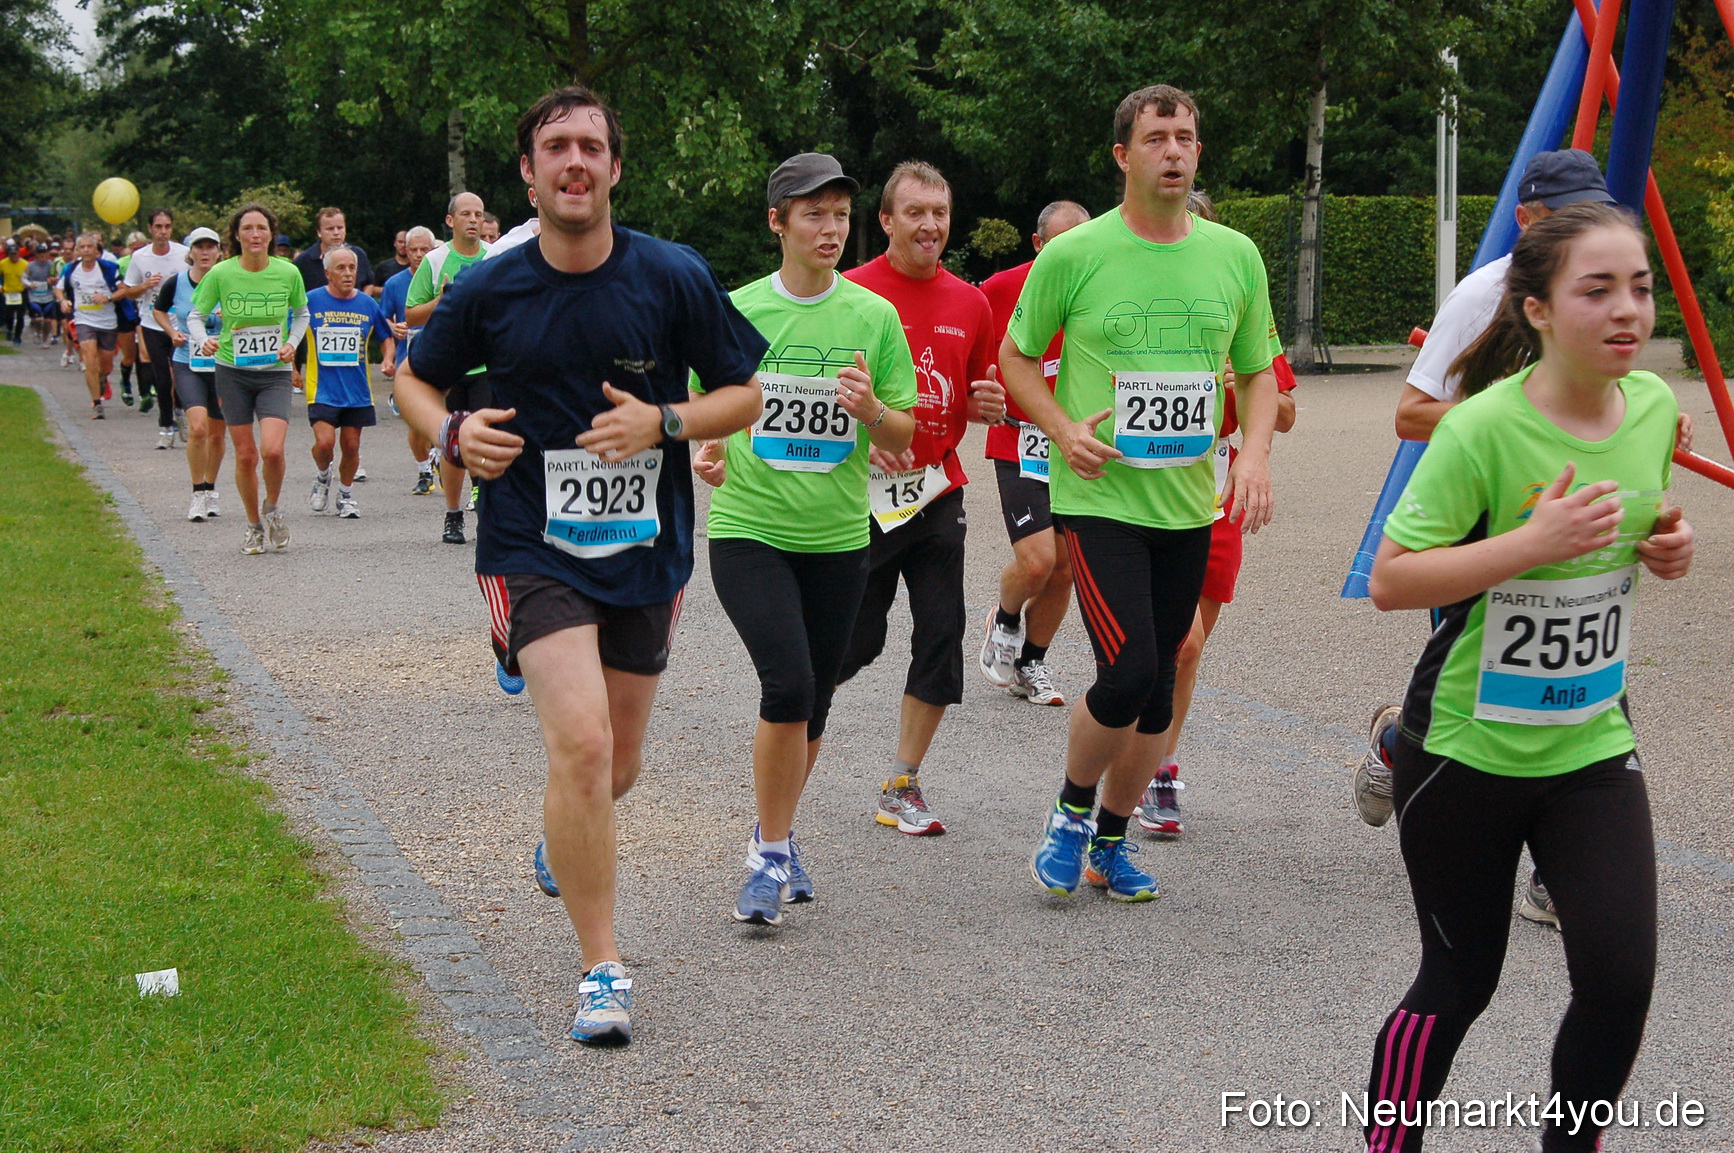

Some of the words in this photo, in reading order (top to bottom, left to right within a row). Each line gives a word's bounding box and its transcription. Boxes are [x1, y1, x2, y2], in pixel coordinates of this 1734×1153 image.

[226, 292, 287, 316] OPF
[324, 317, 361, 325] STADTLAUF
[325, 311, 369, 322] NEUMARKTER
[1103, 299, 1229, 348] OPF
[238, 335, 278, 354] 2412
[322, 337, 356, 351] 2179
[1118, 381, 1153, 391] PARTL
[1156, 382, 1200, 391] Neumarkt
[762, 398, 850, 436] 2385
[1126, 396, 1206, 431] 2384
[785, 443, 821, 458] Anita
[1147, 441, 1184, 455] Armin
[547, 461, 588, 472] PARTL
[591, 459, 640, 470] Neumarkt
[1037, 463, 1049, 473] He
[559, 474, 646, 516] 2923
[567, 525, 638, 542] Ferdinand
[1491, 592, 1549, 608] PARTL
[1554, 587, 1617, 608] Neumarkt
[1501, 605, 1621, 670] 2550
[1540, 684, 1586, 708] Anja
